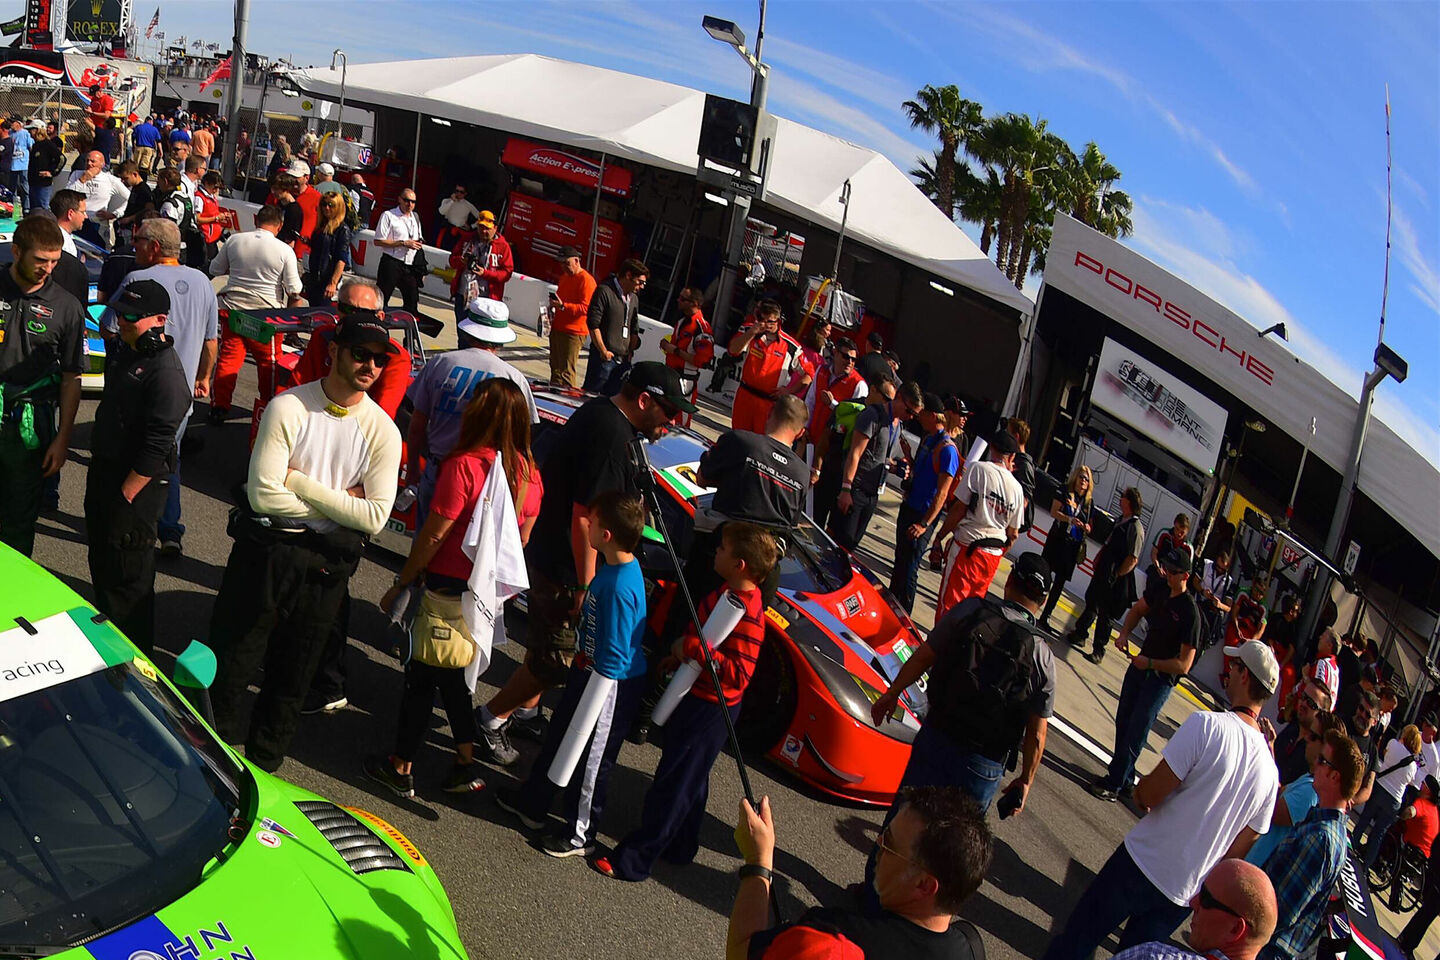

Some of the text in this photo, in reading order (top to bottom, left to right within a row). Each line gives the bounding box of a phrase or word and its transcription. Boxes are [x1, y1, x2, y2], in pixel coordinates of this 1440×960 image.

[529, 153, 562, 167] Action
[730, 181, 756, 193] musco
[1074, 251, 1275, 386] PORSCHE
[746, 457, 775, 476] FLYING
[775, 471, 803, 490] LIZARD
[261, 835, 278, 846] E
